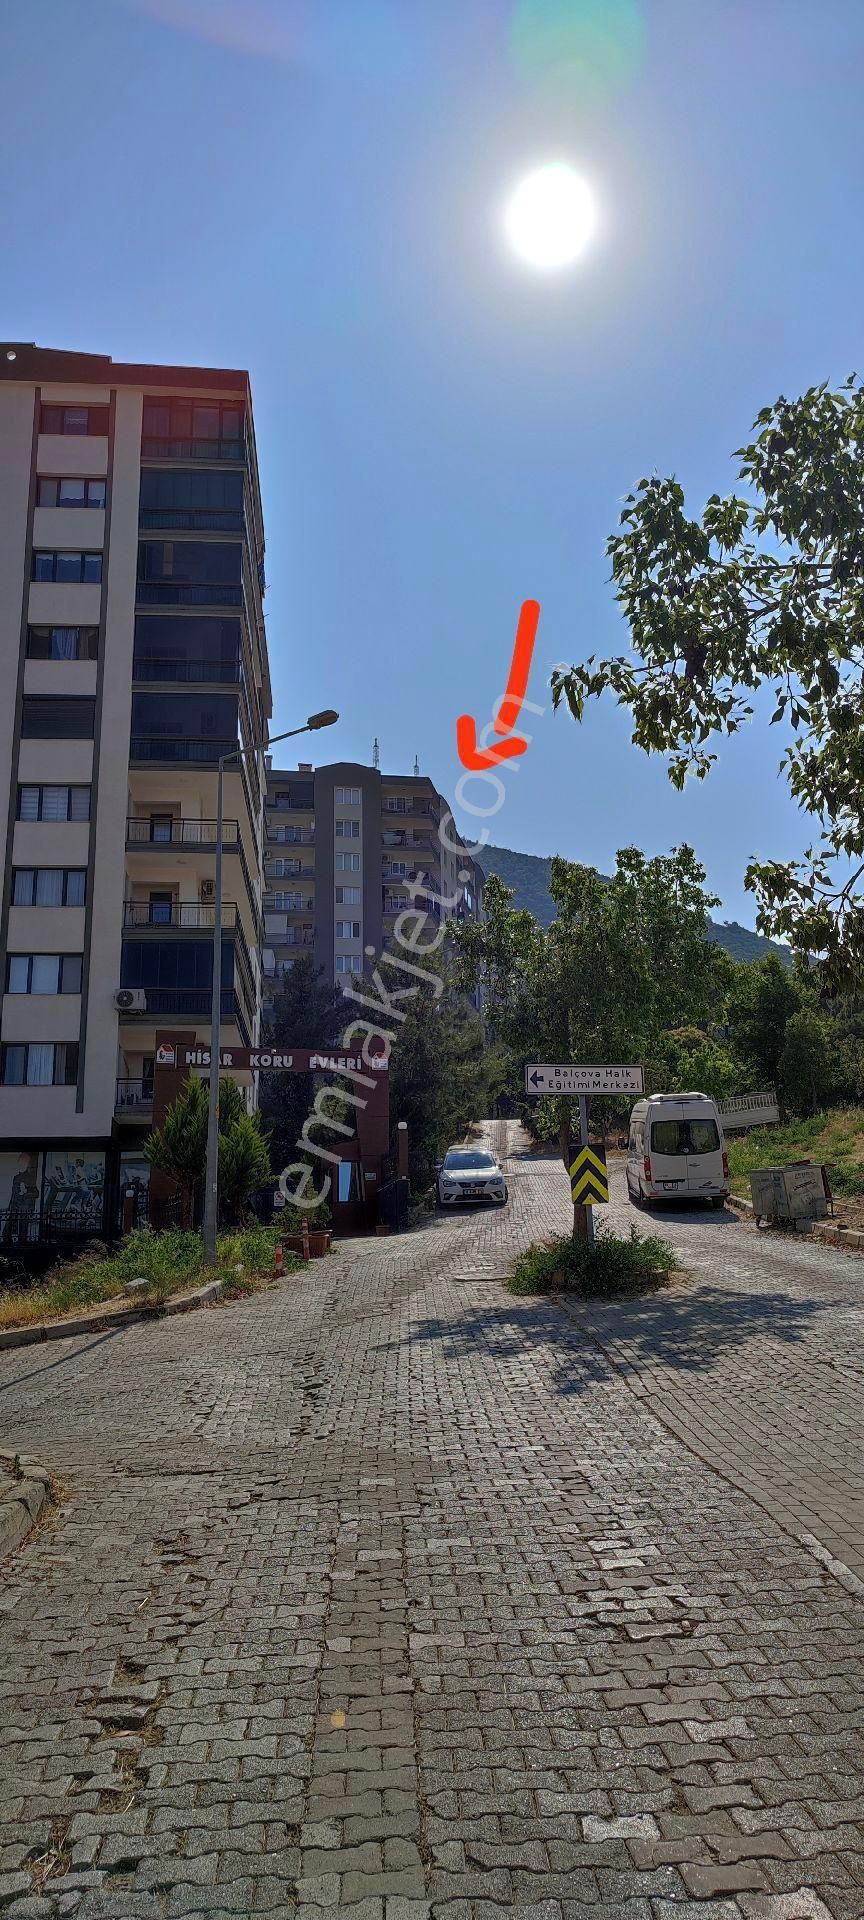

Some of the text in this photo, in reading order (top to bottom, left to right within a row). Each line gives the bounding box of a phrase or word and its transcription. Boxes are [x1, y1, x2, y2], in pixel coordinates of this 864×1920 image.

[249, 1055, 293, 1068] KORU
[309, 1055, 362, 1070] EVLERİ
[554, 1068, 632, 1079] Balçova Halk
[592, 1080, 640, 1089] Merkezi
